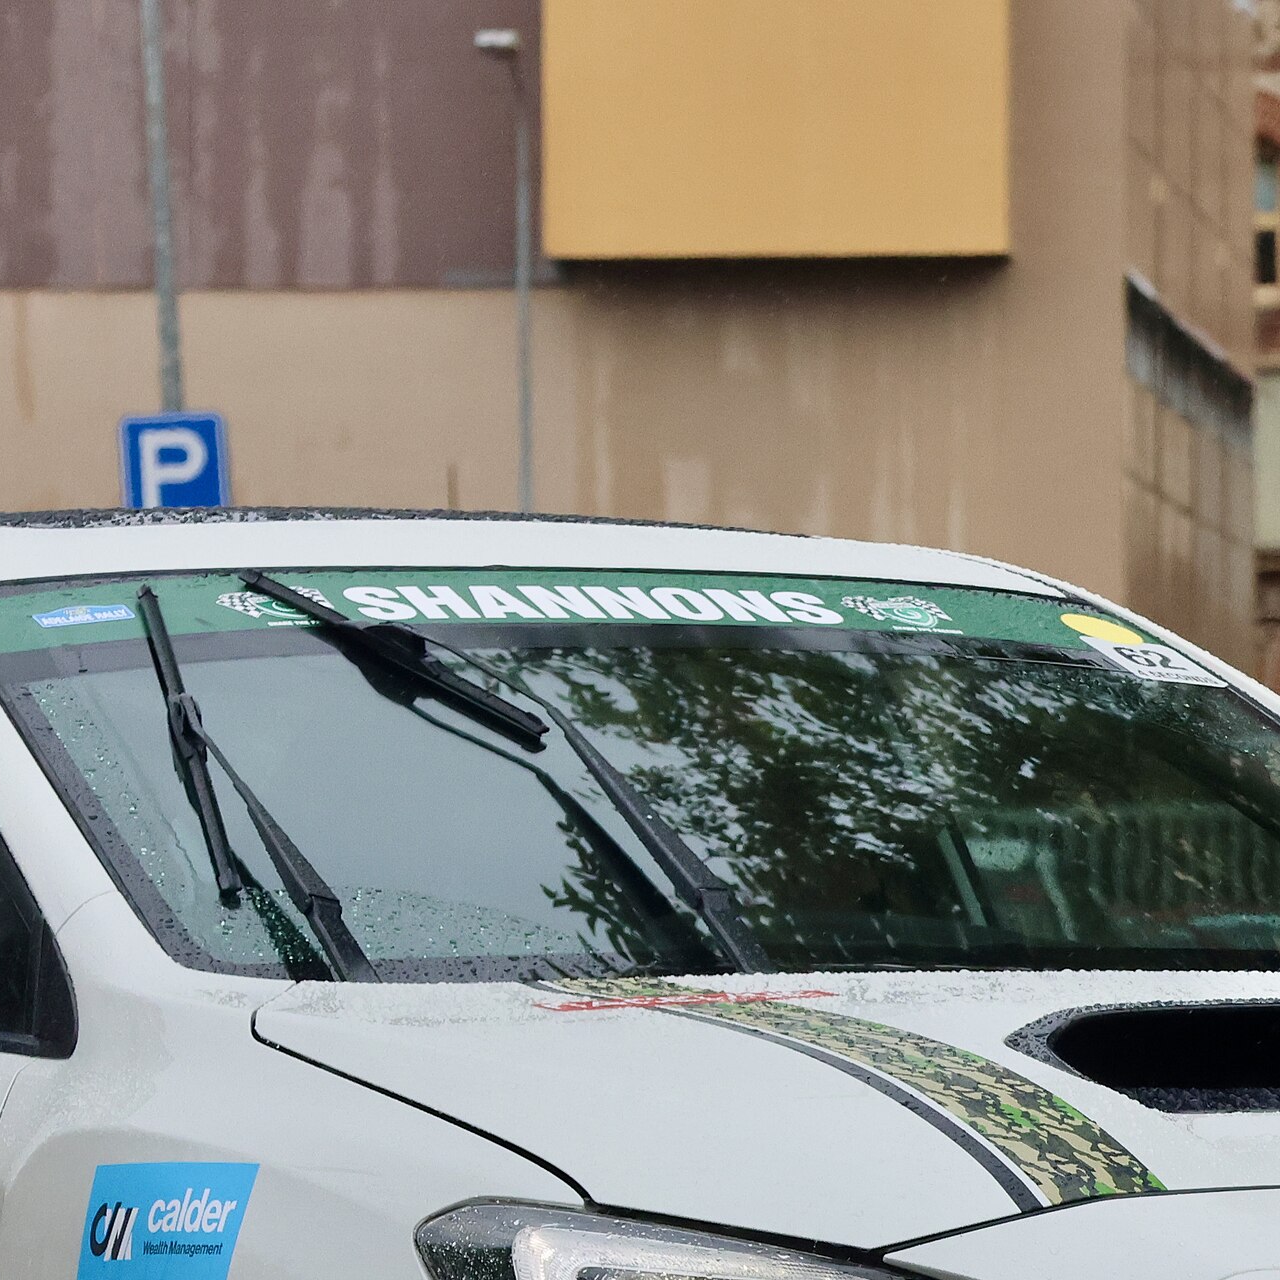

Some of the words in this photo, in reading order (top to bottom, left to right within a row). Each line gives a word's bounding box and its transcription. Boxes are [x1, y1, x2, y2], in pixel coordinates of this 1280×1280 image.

[138, 428, 208, 508] P
[94, 609, 128, 619] RALLY
[342, 585, 845, 625] SHANNONS
[1113, 646, 1188, 671] 62
[148, 1187, 238, 1234] calder
[143, 1240, 169, 1256] Wealth
[169, 1240, 224, 1258] Management
